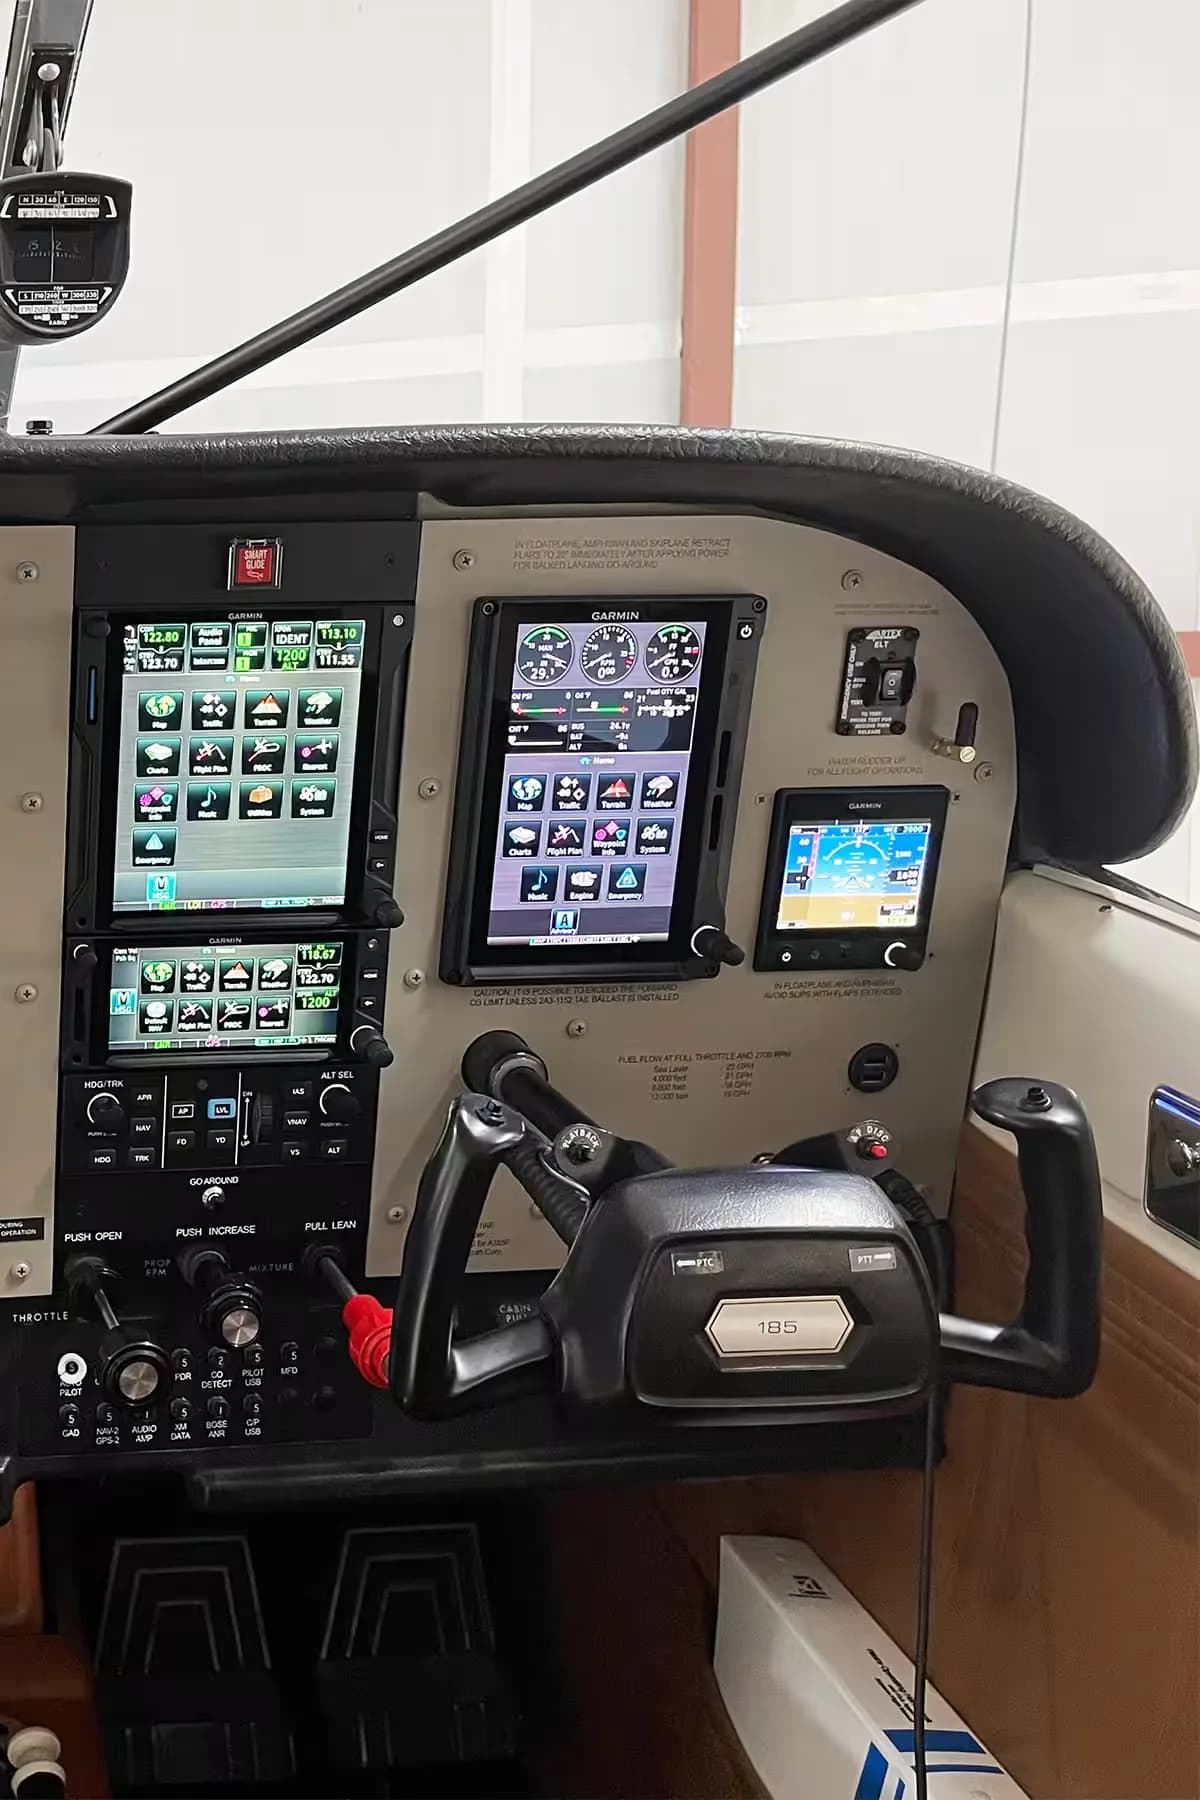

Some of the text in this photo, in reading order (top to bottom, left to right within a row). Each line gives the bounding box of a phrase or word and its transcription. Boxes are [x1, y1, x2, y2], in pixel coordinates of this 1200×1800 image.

[244, 550, 268, 560] SMART
[245, 559, 265, 570] GLIDE
[228, 612, 263, 620] GARMIN
[592, 611, 639, 621] GARMIN
[143, 631, 179, 643] 122.80
[275, 633, 309, 645] IDENT
[321, 628, 357, 640] 113.10
[142, 658, 178, 669] 123.70
[319, 654, 355, 666] 111.55
[509, 848, 532, 856] Charts
[301, 949, 335, 960] 118.67
[300, 974, 334, 984] 122.70
[301, 997, 330, 1008] 1200
[321, 1071, 354, 1080] ALT SEL
[84, 1080, 124, 1089] HDG/TRK
[177, 1107, 189, 1115] AP
[215, 1106, 229, 1114] LVL
[287, 1118, 307, 1126] VNAV
[136, 1124, 151, 1132] NAV
[176, 1138, 187, 1146] FD
[215, 1136, 226, 1144] YD
[562, 1128, 600, 1150] PLAYBACK
[134, 1154, 149, 1162] TRK
[290, 1149, 300, 1157] VS
[94, 1156, 111, 1164] HDG
[190, 1176, 239, 1186] GO AROUND
[176, 1224, 256, 1237] PUSH INCREASE
[305, 1220, 356, 1232] PULL LEAN
[1, 1228, 37, 1238] OPERATION
[64, 1231, 122, 1243] PUSH OPEN
[696, 1258, 714, 1267] PTC
[857, 1254, 873, 1264] PTT
[248, 1263, 294, 1273] MIXTURE
[12, 1311, 69, 1323] THROTTLE
[758, 1320, 798, 1335] 185
[211, 1370, 223, 1379] CO
[242, 1368, 264, 1377] PILOT
[280, 1366, 298, 1375] MFD
[201, 1379, 232, 1389] DETECT
[245, 1377, 262, 1387] USB
[59, 1387, 82, 1397] PILOT
[132, 1424, 157, 1434] AUDIO
[174, 1423, 187, 1431] XM
[206, 1420, 228, 1429] BOSE
[96, 1426, 119, 1436] NAV-2
[170, 1431, 191, 1441] DATA
[208, 1429, 226, 1438] ANR
[245, 1427, 262, 1436] USB
[96, 1435, 120, 1445] GPS-2
[135, 1433, 153, 1442] AMP
